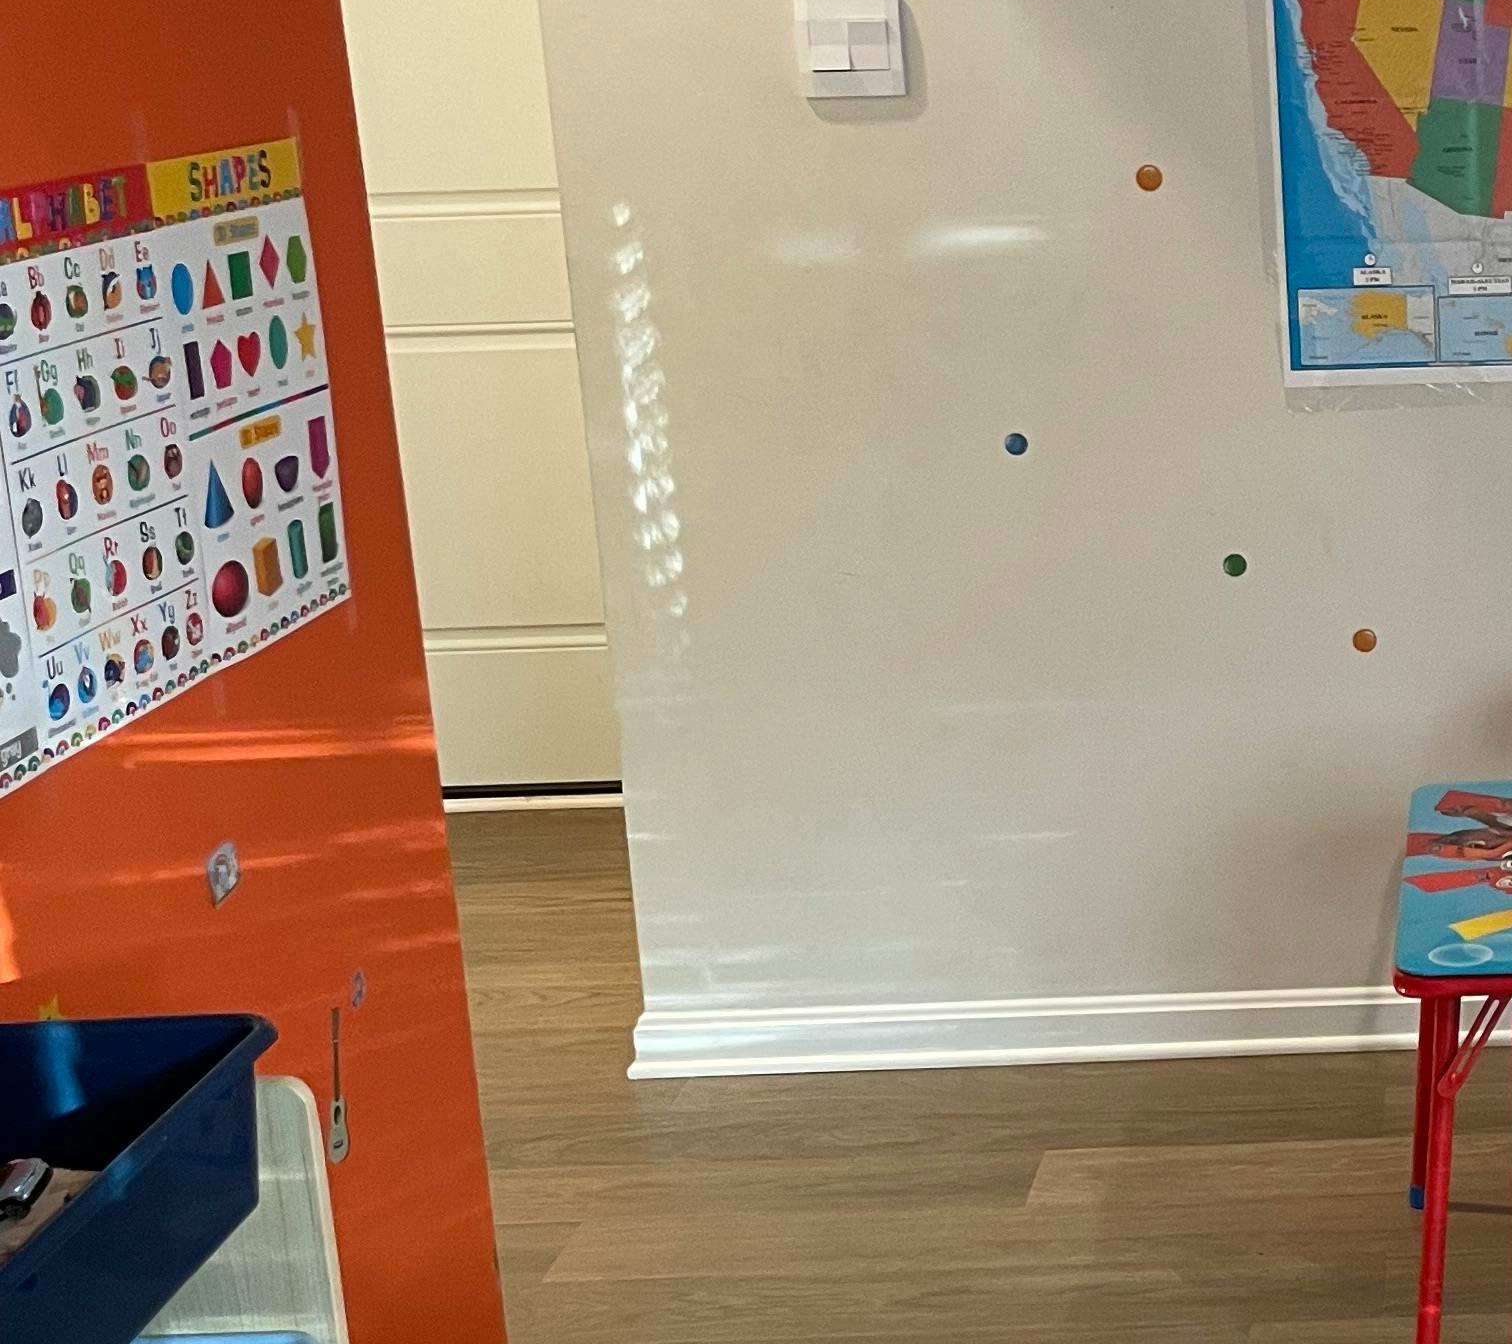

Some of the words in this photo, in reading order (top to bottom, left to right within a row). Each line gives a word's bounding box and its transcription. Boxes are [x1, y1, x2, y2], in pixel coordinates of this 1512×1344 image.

[188, 149, 271, 202] SHAPES
[99, 248, 115, 270] Dd
[134, 241, 149, 262] Ee
[27, 266, 45, 289] Bb
[64, 257, 80, 279] Cc
[76, 348, 93, 371] Hh
[40, 360, 58, 386] Gg
[160, 417, 176, 437] Oo
[125, 428, 142, 450] Nn
[86, 441, 109, 464] Mm
[18, 467, 36, 492] Kk
[174, 507, 187, 527] Tt
[140, 522, 156, 543] Ss
[104, 537, 118, 557] Rr
[159, 601, 175, 624] Yy
[131, 614, 148, 636] Xx
[98, 628, 121, 651] Ww
[73, 641, 90, 664] Vv
[46, 656, 63, 679] Uu
